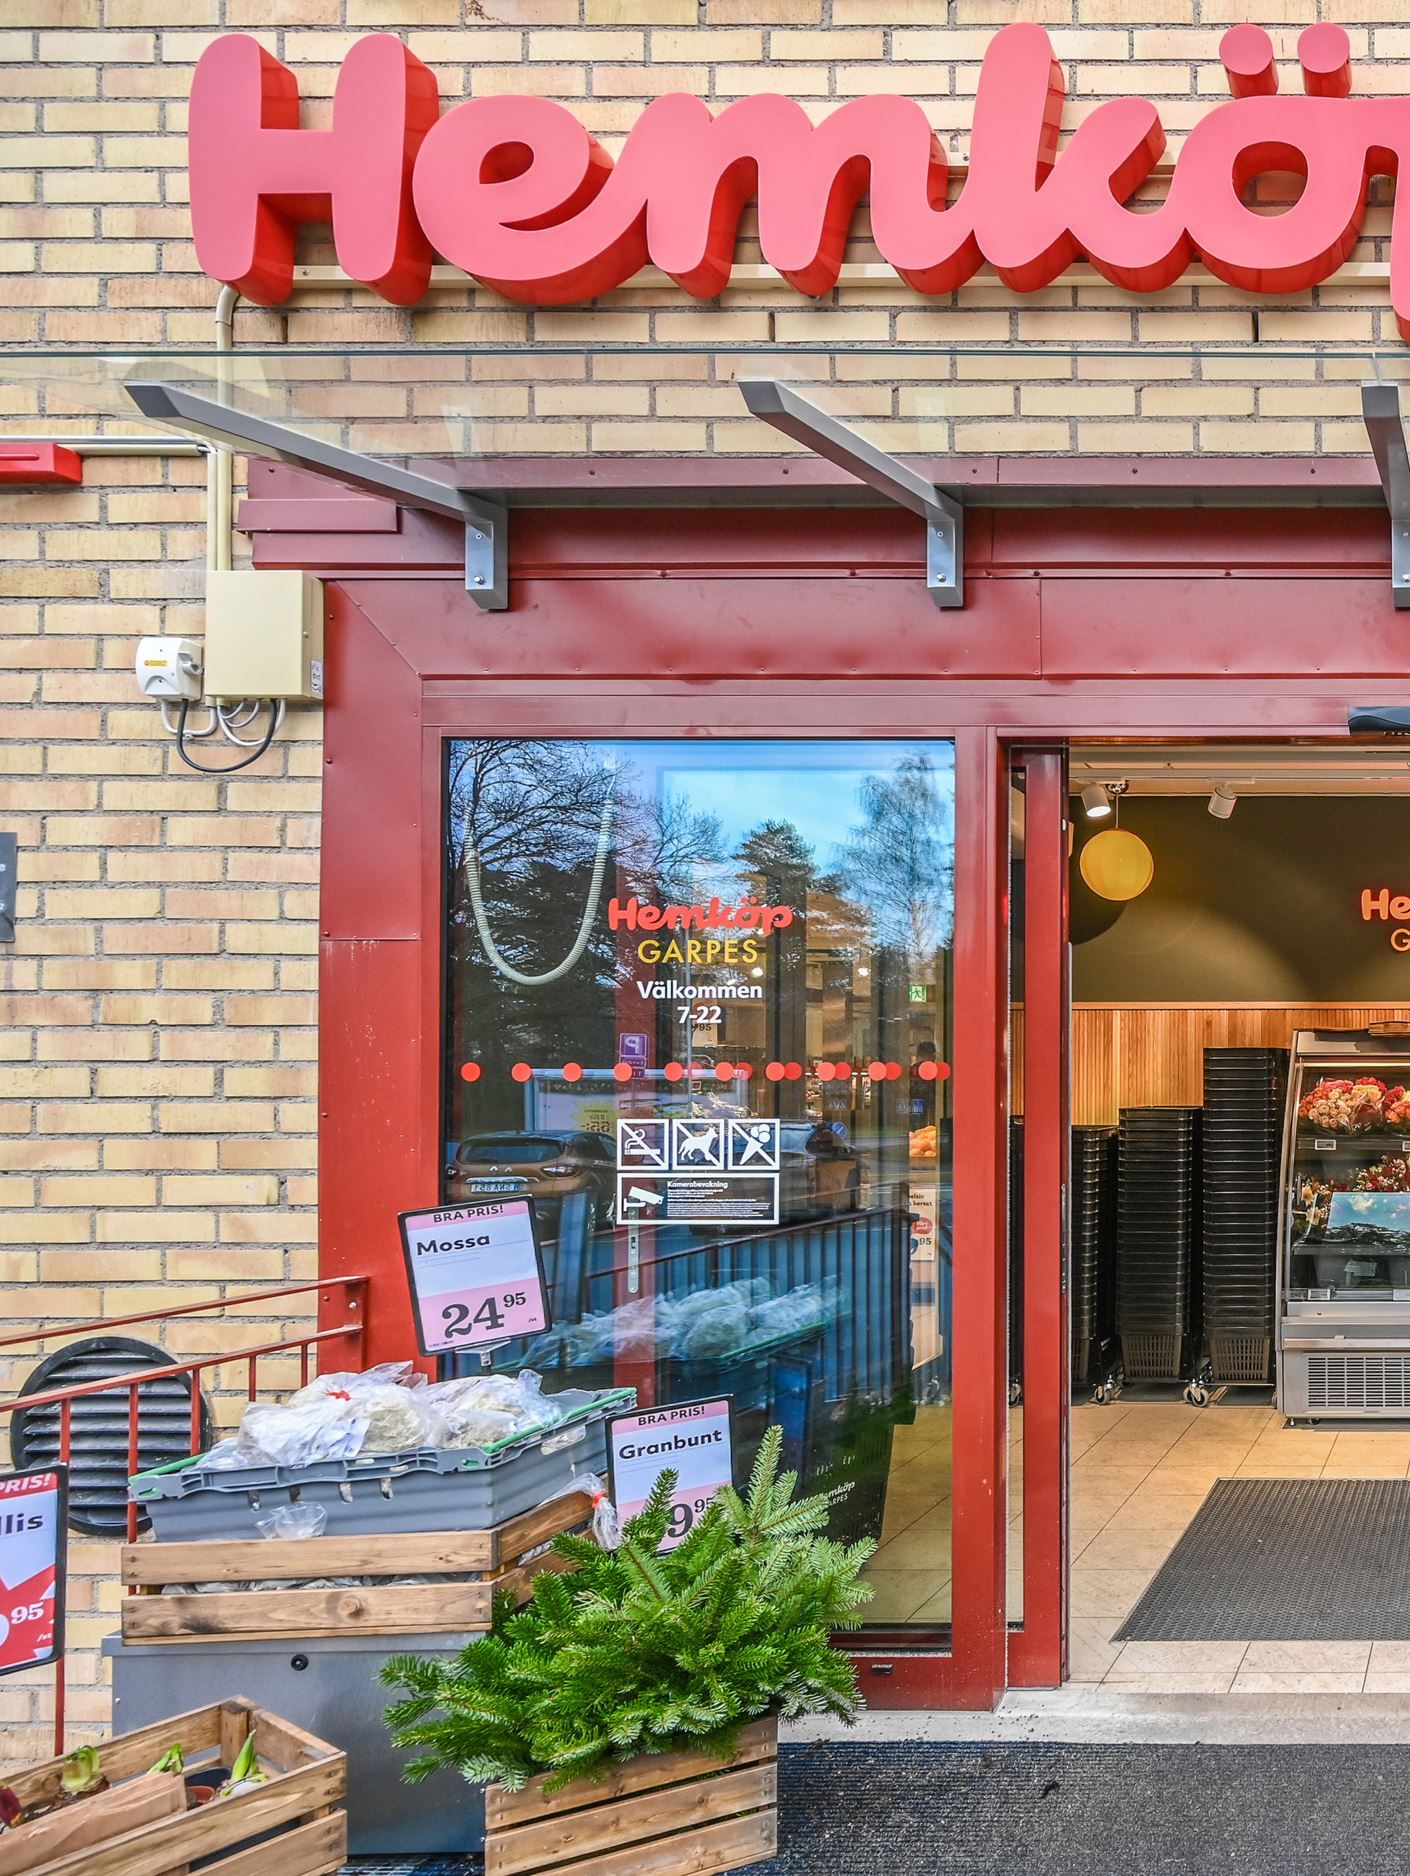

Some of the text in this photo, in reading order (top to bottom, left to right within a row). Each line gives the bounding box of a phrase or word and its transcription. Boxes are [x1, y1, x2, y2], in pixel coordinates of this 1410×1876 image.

[607, 897, 793, 935] Hemköp
[637, 939, 759, 964] GARPES
[637, 979, 763, 1000] Välkommen
[677, 1005, 722, 1024] 7-22
[433, 1204, 504, 1223] BRA PRIS!
[416, 1235, 490, 1256] Mossa
[638, 1406, 705, 1426] BRA PRIS!
[619, 1429, 723, 1460] Granbunt
